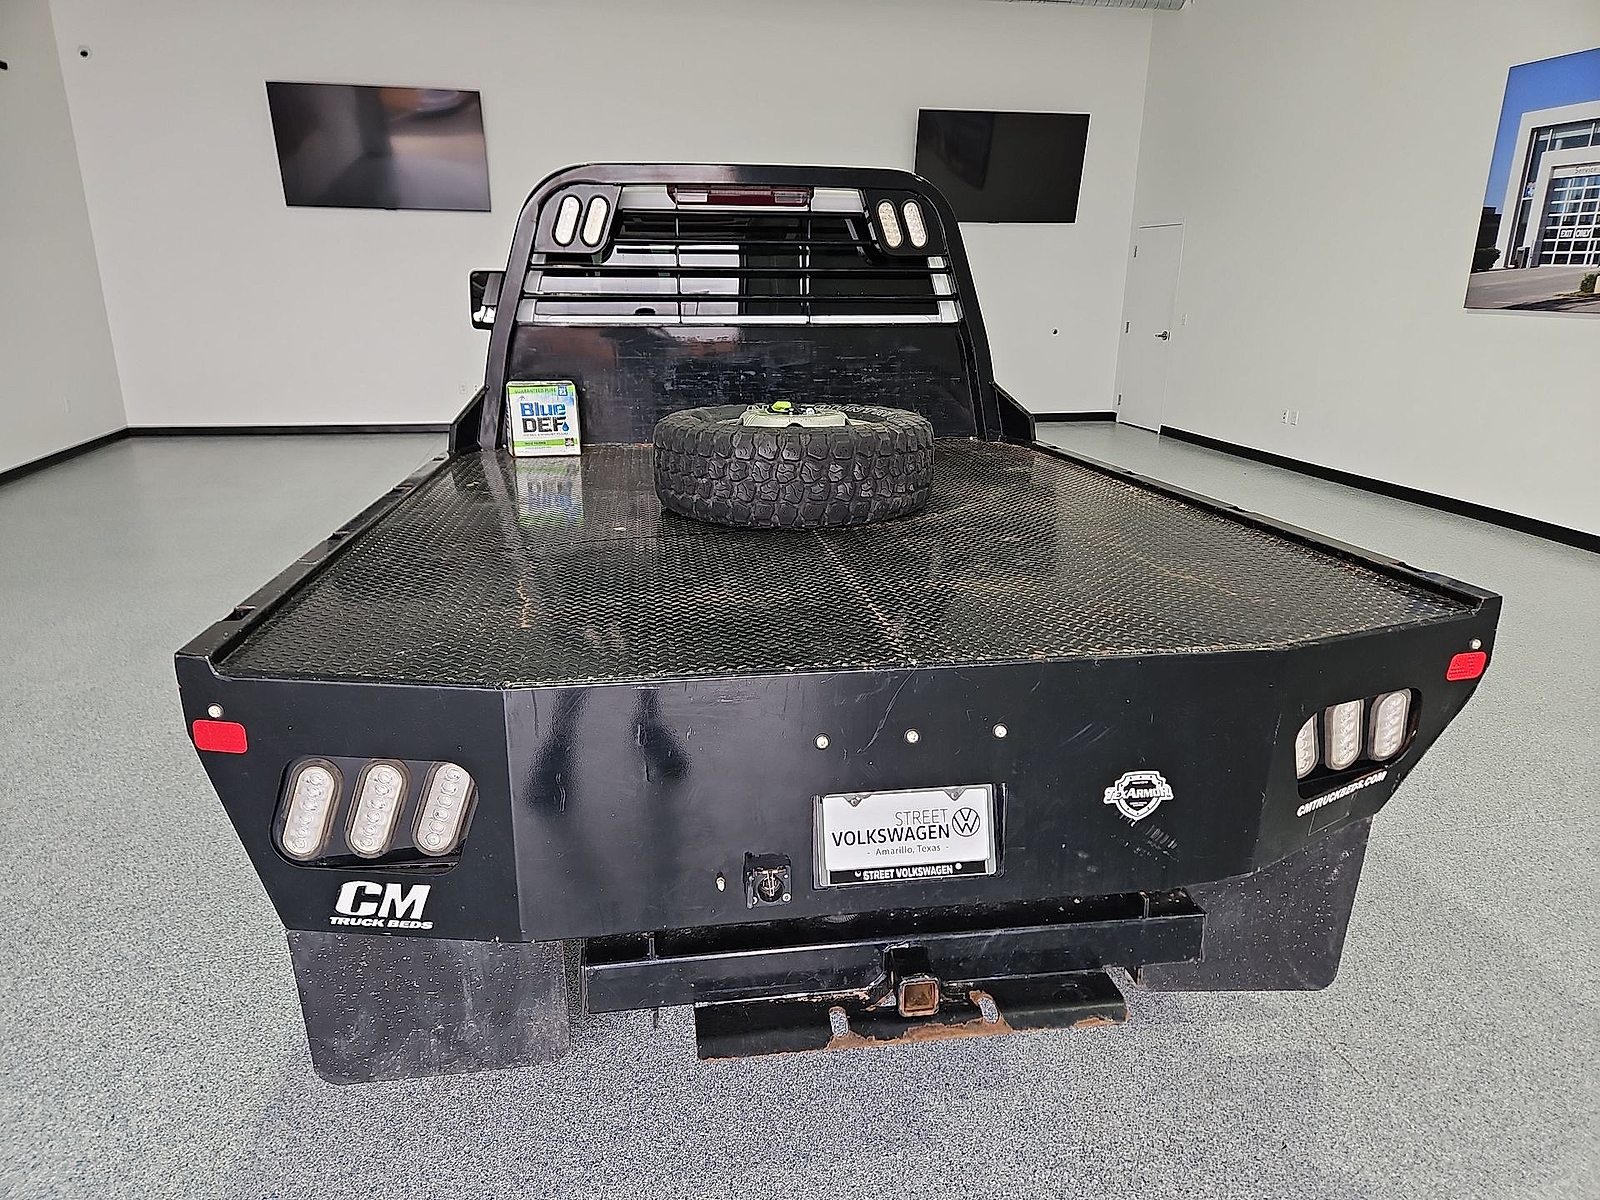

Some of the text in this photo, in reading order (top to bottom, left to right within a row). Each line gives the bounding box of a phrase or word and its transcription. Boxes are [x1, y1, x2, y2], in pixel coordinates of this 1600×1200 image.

[520, 402, 566, 416] Blue
[522, 416, 566, 433] DEF
[895, 808, 948, 827] STREET
[831, 823, 950, 847] VOLKSWAGEN
[875, 845, 915, 856] Amarillo,
[916, 844, 941, 853] Texas
[862, 864, 954, 881] STREET VOLKSWAGEN
[335, 881, 431, 919] CM
[329, 917, 434, 930] TRUCK BEDS
